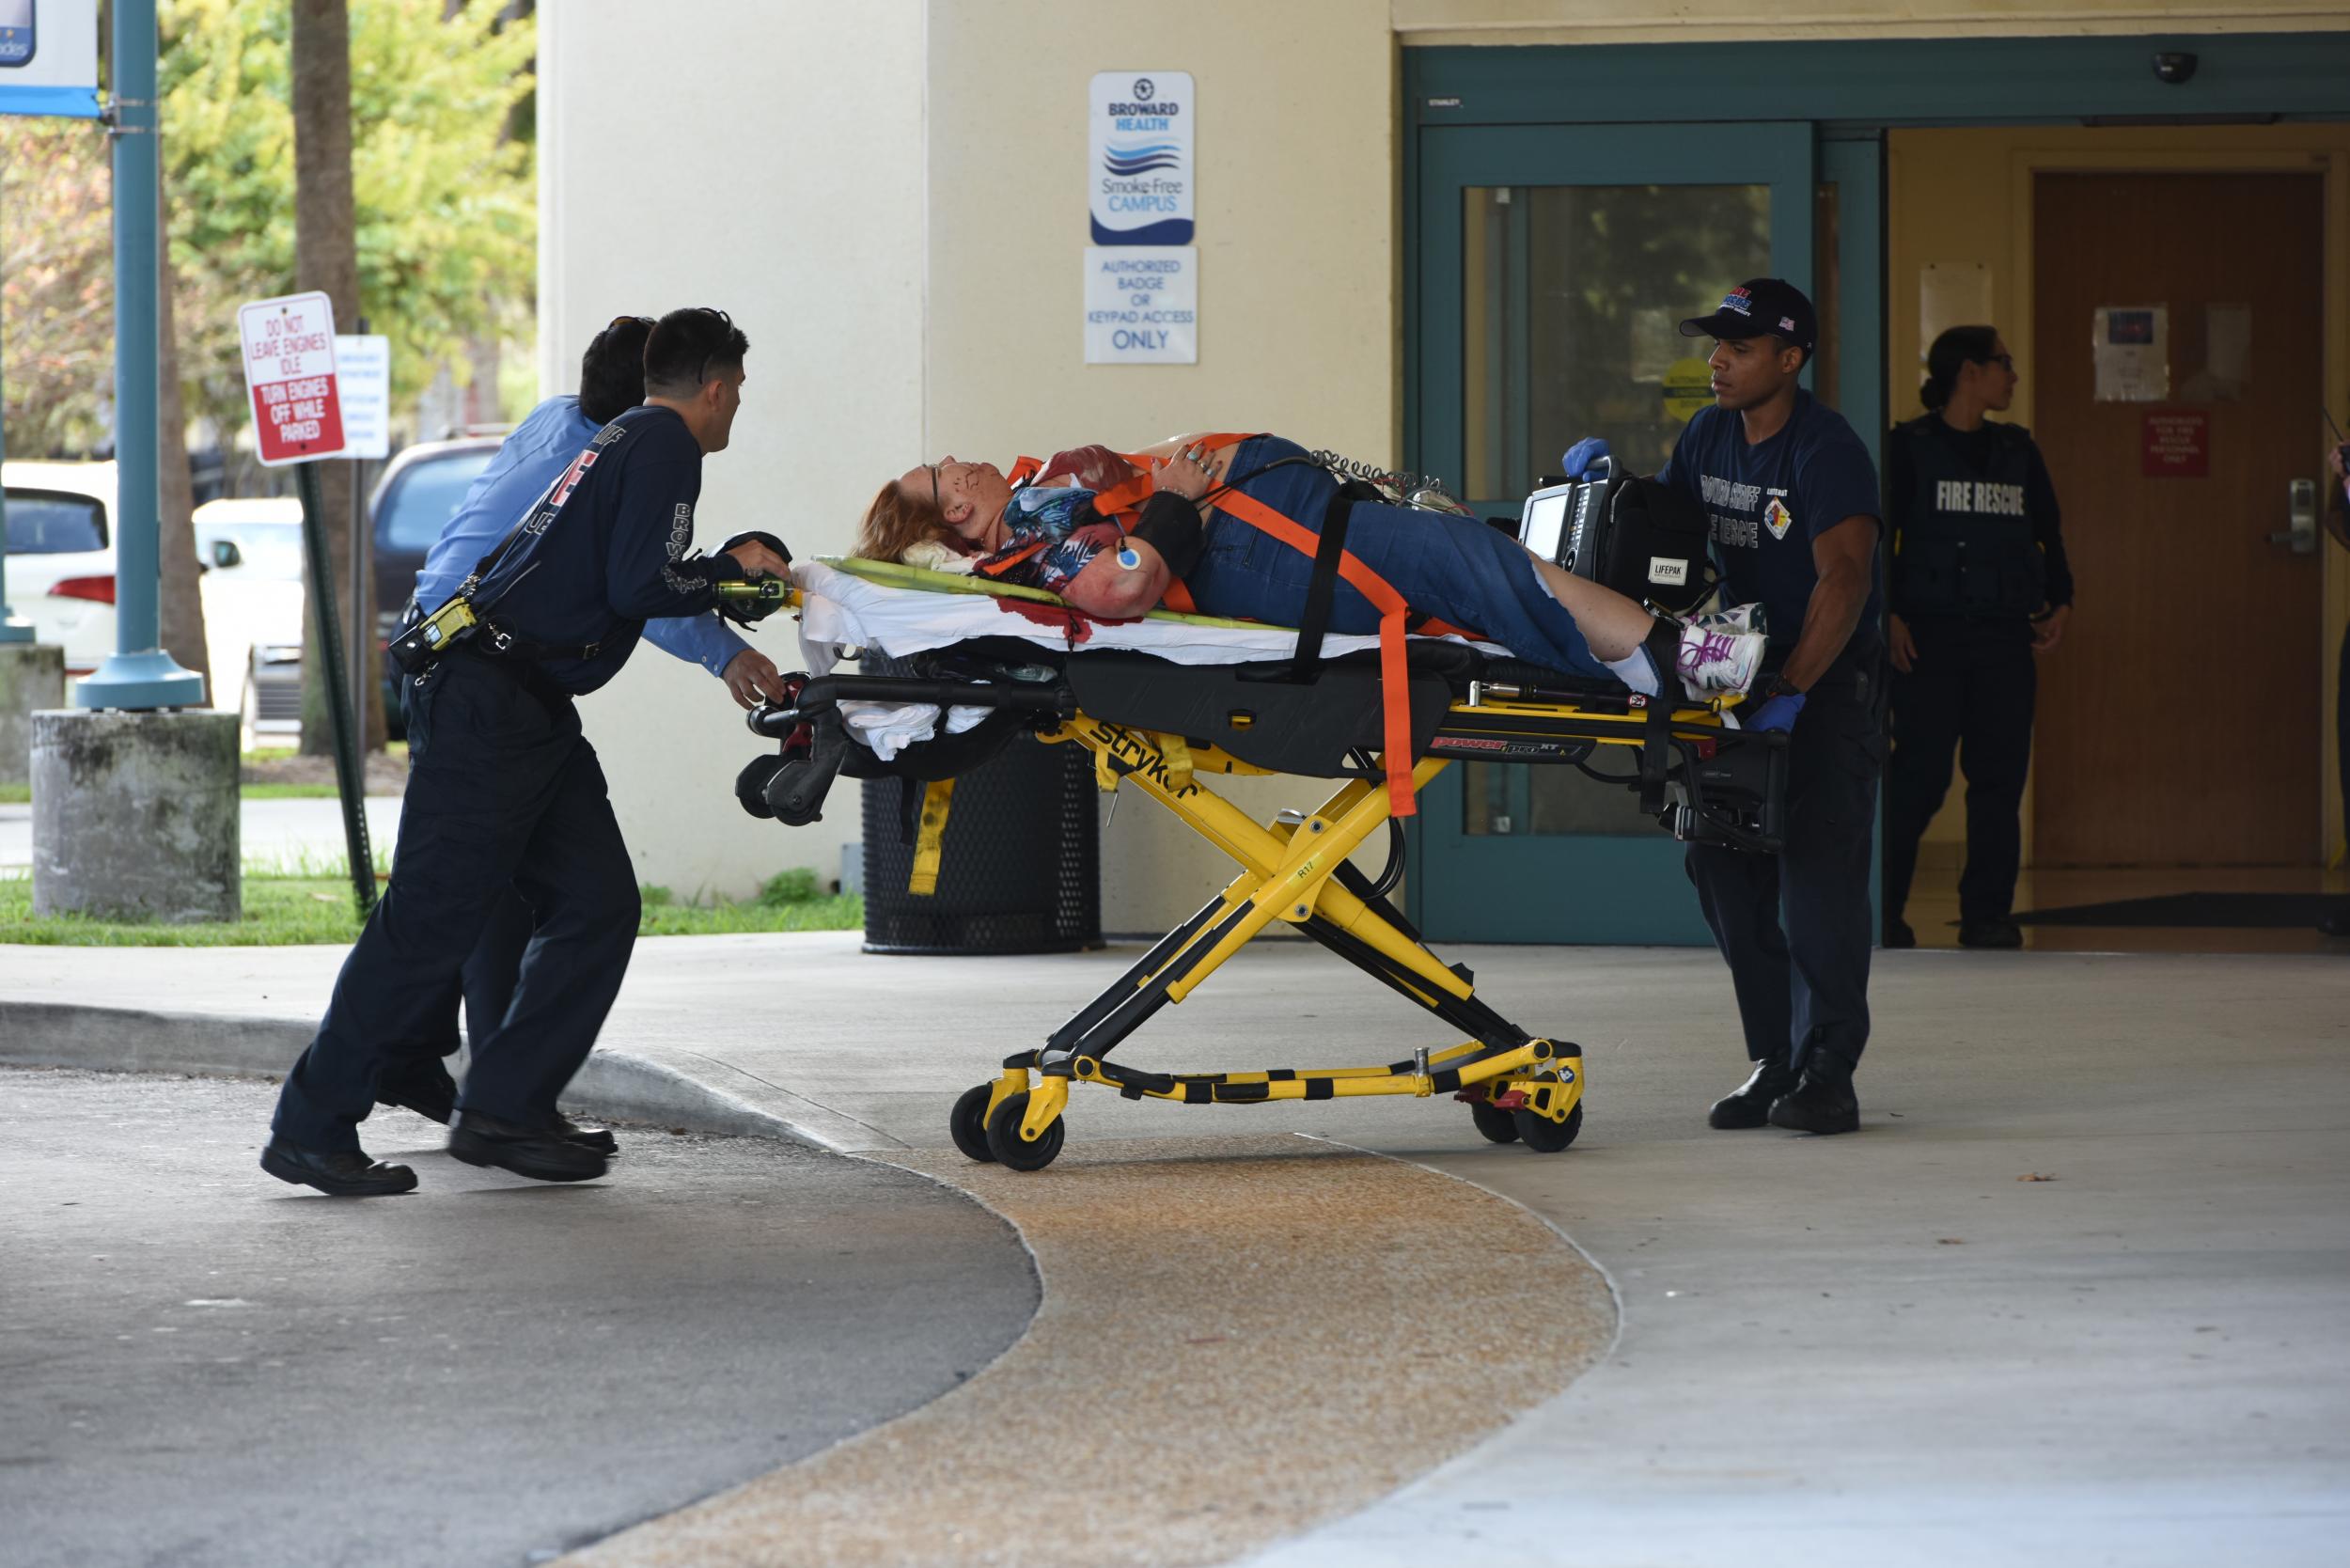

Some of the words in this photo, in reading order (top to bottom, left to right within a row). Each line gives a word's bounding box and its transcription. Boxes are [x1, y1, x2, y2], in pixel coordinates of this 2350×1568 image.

[1108, 102, 1179, 116] BROWARD
[1116, 118, 1168, 131] HEALTH
[1102, 178, 1183, 195] Smoke-Free
[1108, 196, 1178, 212] CAMPUS
[1102, 260, 1181, 273] AUTHORIZED
[1118, 276, 1165, 290] BADGE
[1130, 293, 1150, 306] OR
[1088, 310, 1138, 323] KEYPAD
[1141, 310, 1194, 323] ACCESS
[265, 319, 281, 337] DO
[284, 315, 304, 334] NOT
[251, 339, 281, 361] LEAVE
[283, 332, 326, 356] ENGINES
[1112, 329, 1168, 350] ONLY
[280, 356, 302, 375] IDLE
[260, 383, 288, 404] TURN
[288, 376, 329, 401] ENGINES
[270, 403, 291, 426] OFF
[292, 398, 326, 420] WHILE
[280, 419, 321, 443] PARKED
[1936, 479, 1972, 511] FIRE
[1974, 481, 2025, 516] RESCUE
[1654, 564, 1682, 575] LIFEPAK
[1297, 860, 1313, 879] R17
